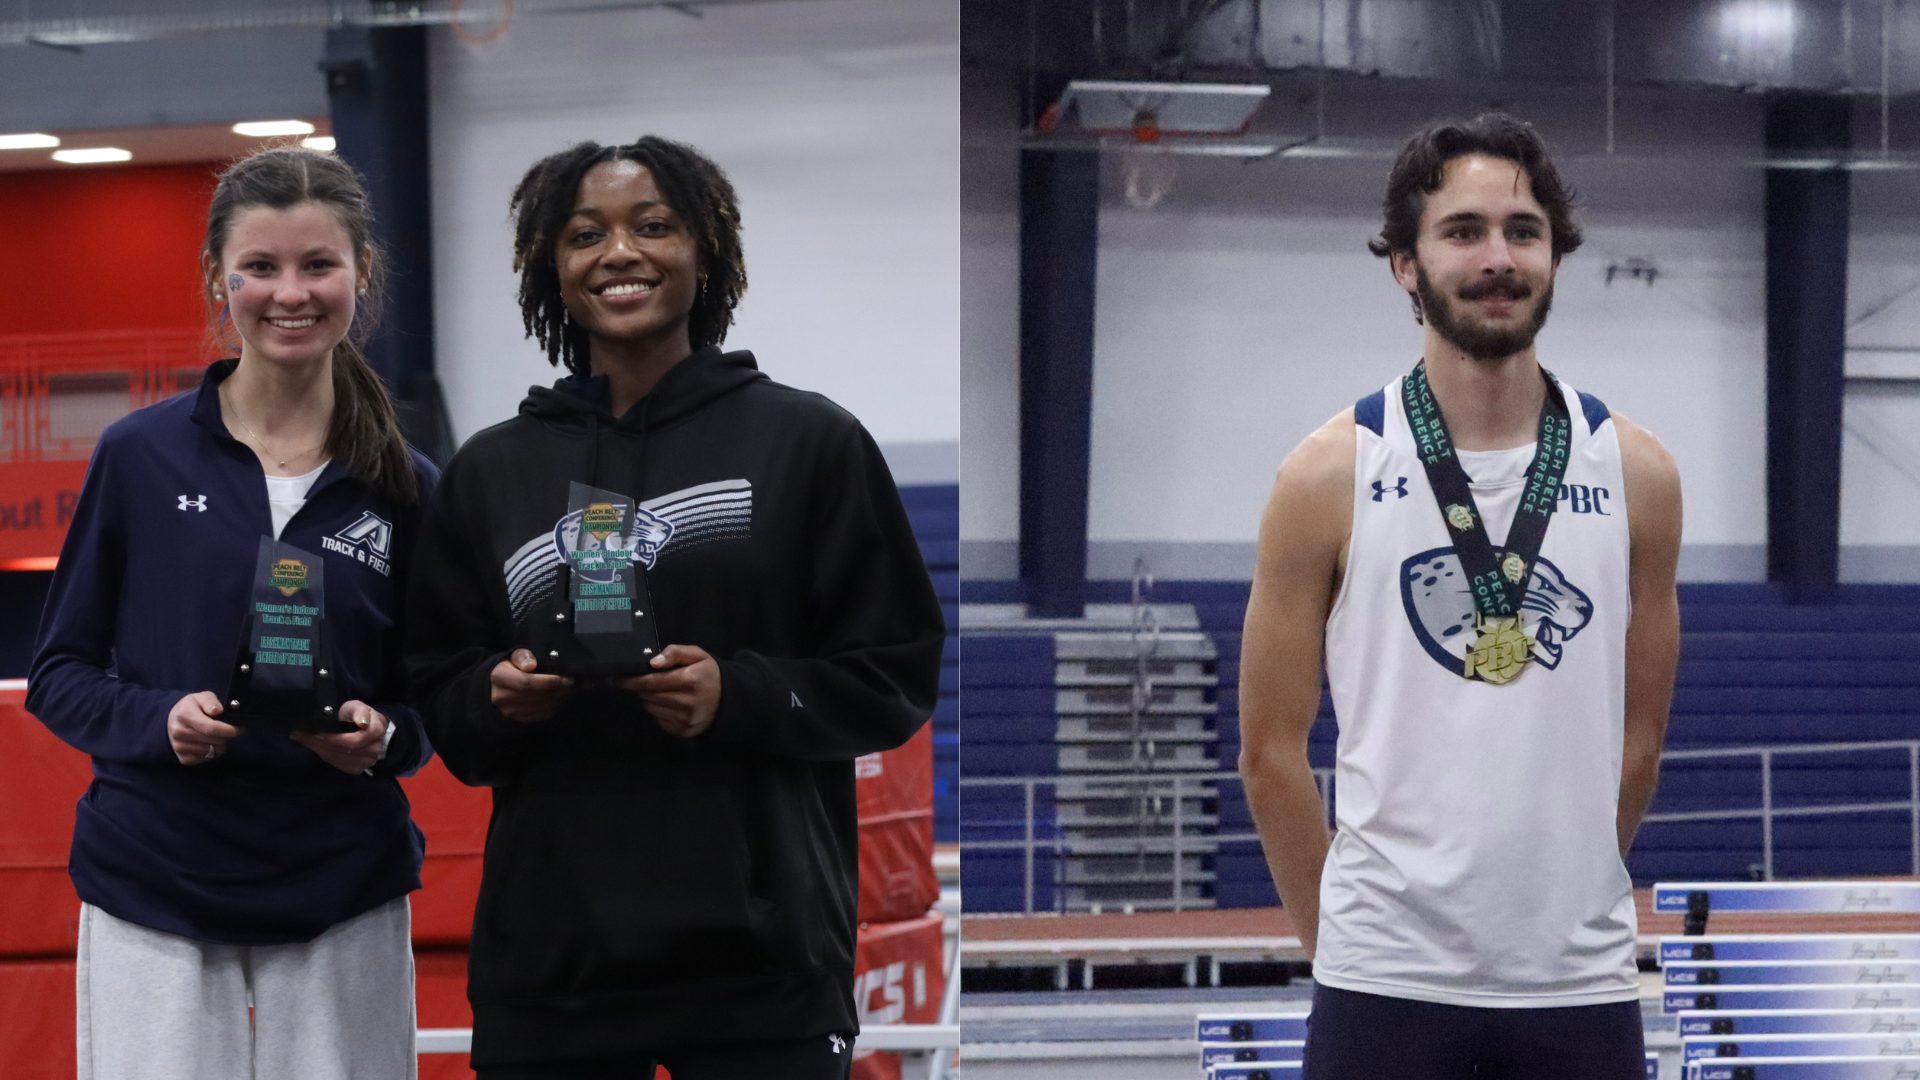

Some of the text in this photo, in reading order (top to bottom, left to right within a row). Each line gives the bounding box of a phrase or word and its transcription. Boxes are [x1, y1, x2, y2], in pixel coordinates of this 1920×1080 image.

[1417, 363, 1451, 458] PEACH BELT
[1523, 415, 1555, 513] CONFERENCE
[1538, 419, 1568, 517] PEACH BELT
[322, 536, 391, 577] TRACK & FIELD
[571, 549, 633, 559] Women's Indoor
[578, 561, 600, 570] Track
[608, 560, 628, 570] Field
[580, 583, 626, 596] FRESHMAN FIELD
[256, 602, 319, 616] Women's Indoor
[262, 614, 285, 625] Track
[292, 615, 312, 627] Field
